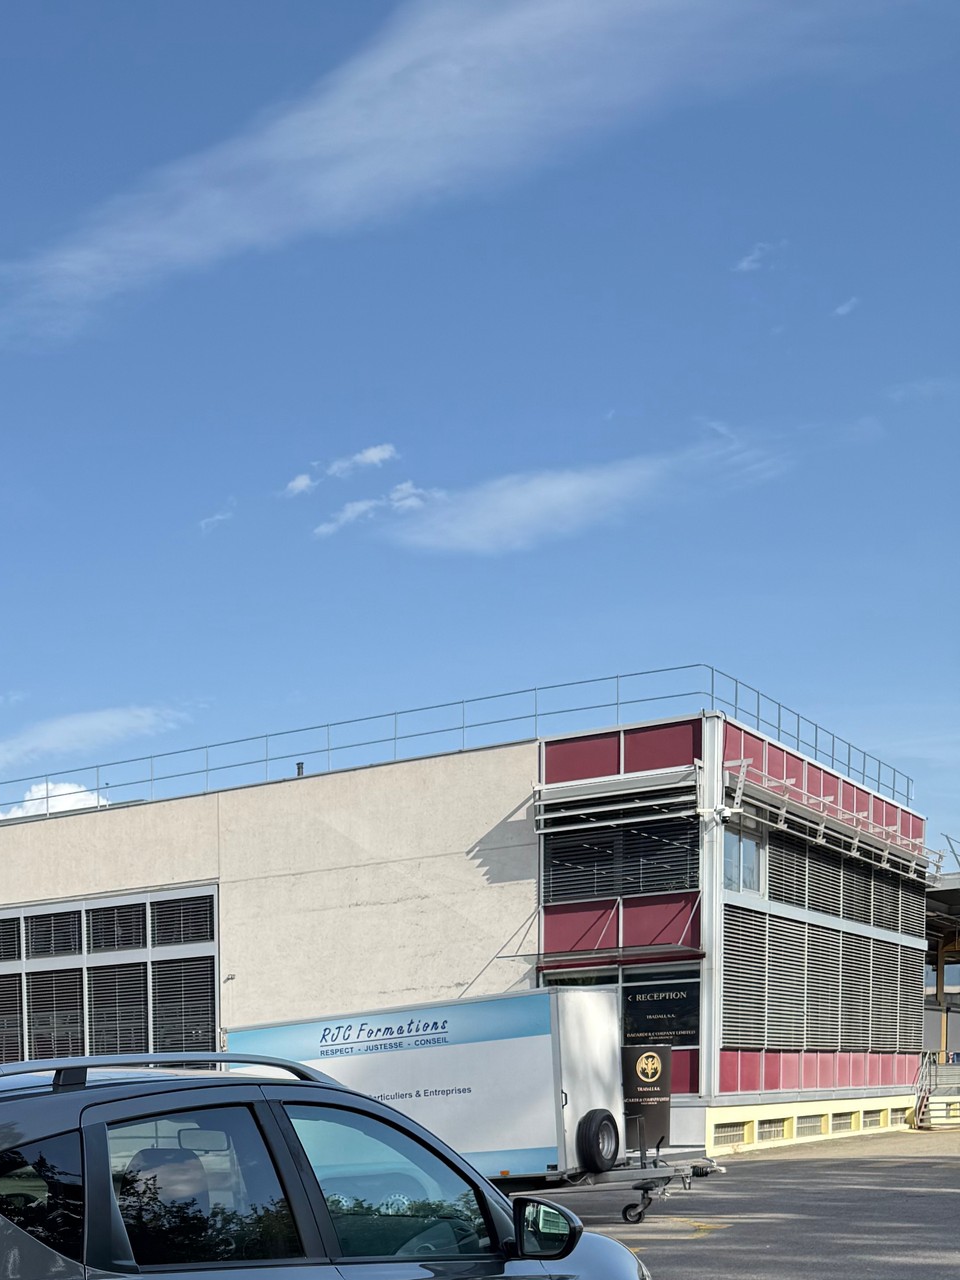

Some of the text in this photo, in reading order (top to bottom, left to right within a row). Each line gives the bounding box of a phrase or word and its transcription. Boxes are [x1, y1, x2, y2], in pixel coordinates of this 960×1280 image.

[636, 991, 687, 1001] RECEPTION
[320, 1019, 448, 1043] RJC Formations
[320, 1047, 354, 1057] RESPECT
[364, 1041, 403, 1052] JUSTESSE
[414, 1036, 449, 1046] CONSEIL
[414, 1090, 421, 1098] &
[423, 1086, 472, 1097] Entreprises
